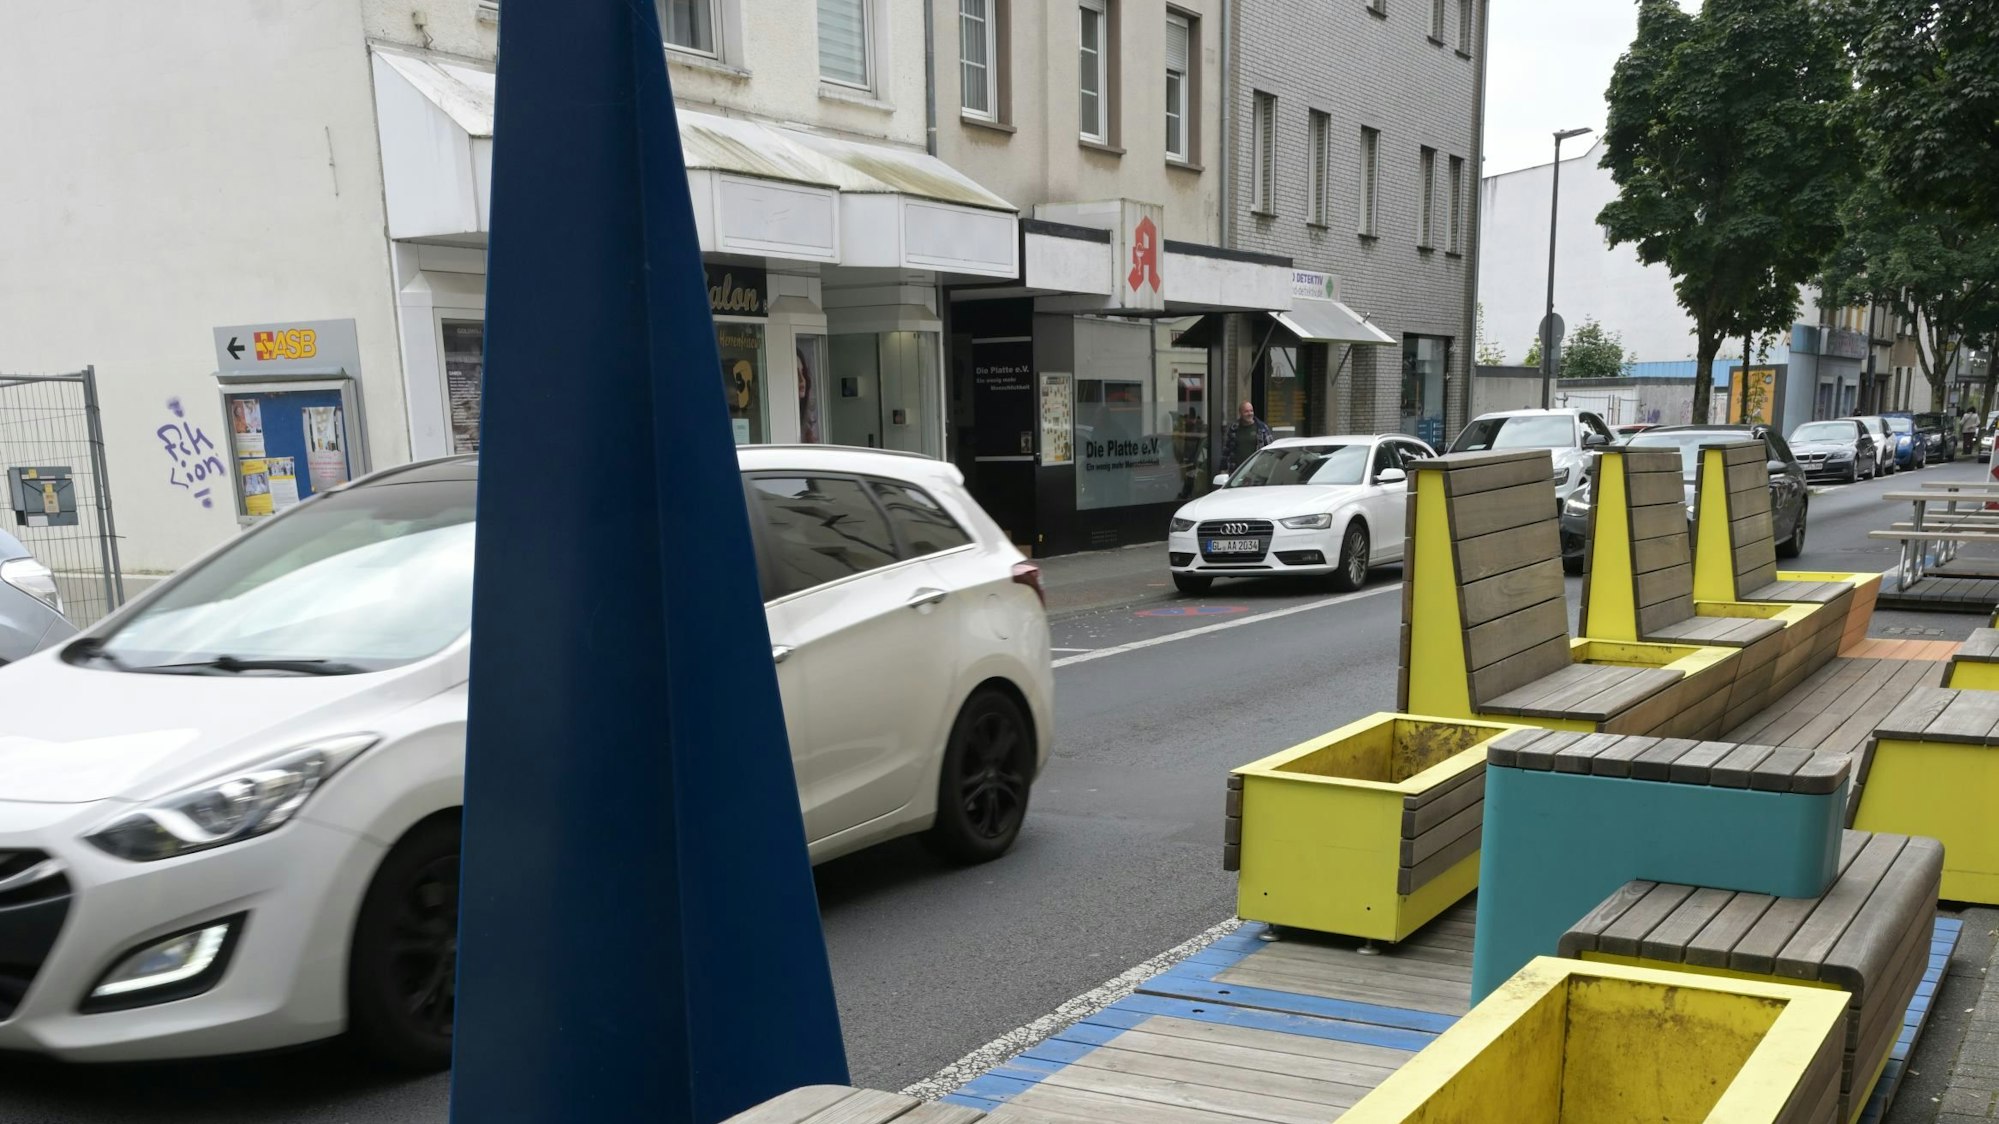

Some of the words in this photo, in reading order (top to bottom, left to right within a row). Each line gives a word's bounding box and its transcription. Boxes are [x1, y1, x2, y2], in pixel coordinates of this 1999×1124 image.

[1296, 272, 1323, 286] DETEKTIV
[706, 271, 759, 312] alon
[271, 329, 317, 360] ASB
[976, 367, 989, 375] Die
[990, 366, 1014, 374] Platte
[1015, 365, 1030, 373] e.V.
[1086, 441, 1104, 458] Die
[1107, 439, 1139, 457] Platte
[1141, 436, 1160, 455] e.V.
[1212, 541, 1222, 551] GL
[1227, 541, 1237, 550] AA
[1238, 540, 1258, 551] 2034
